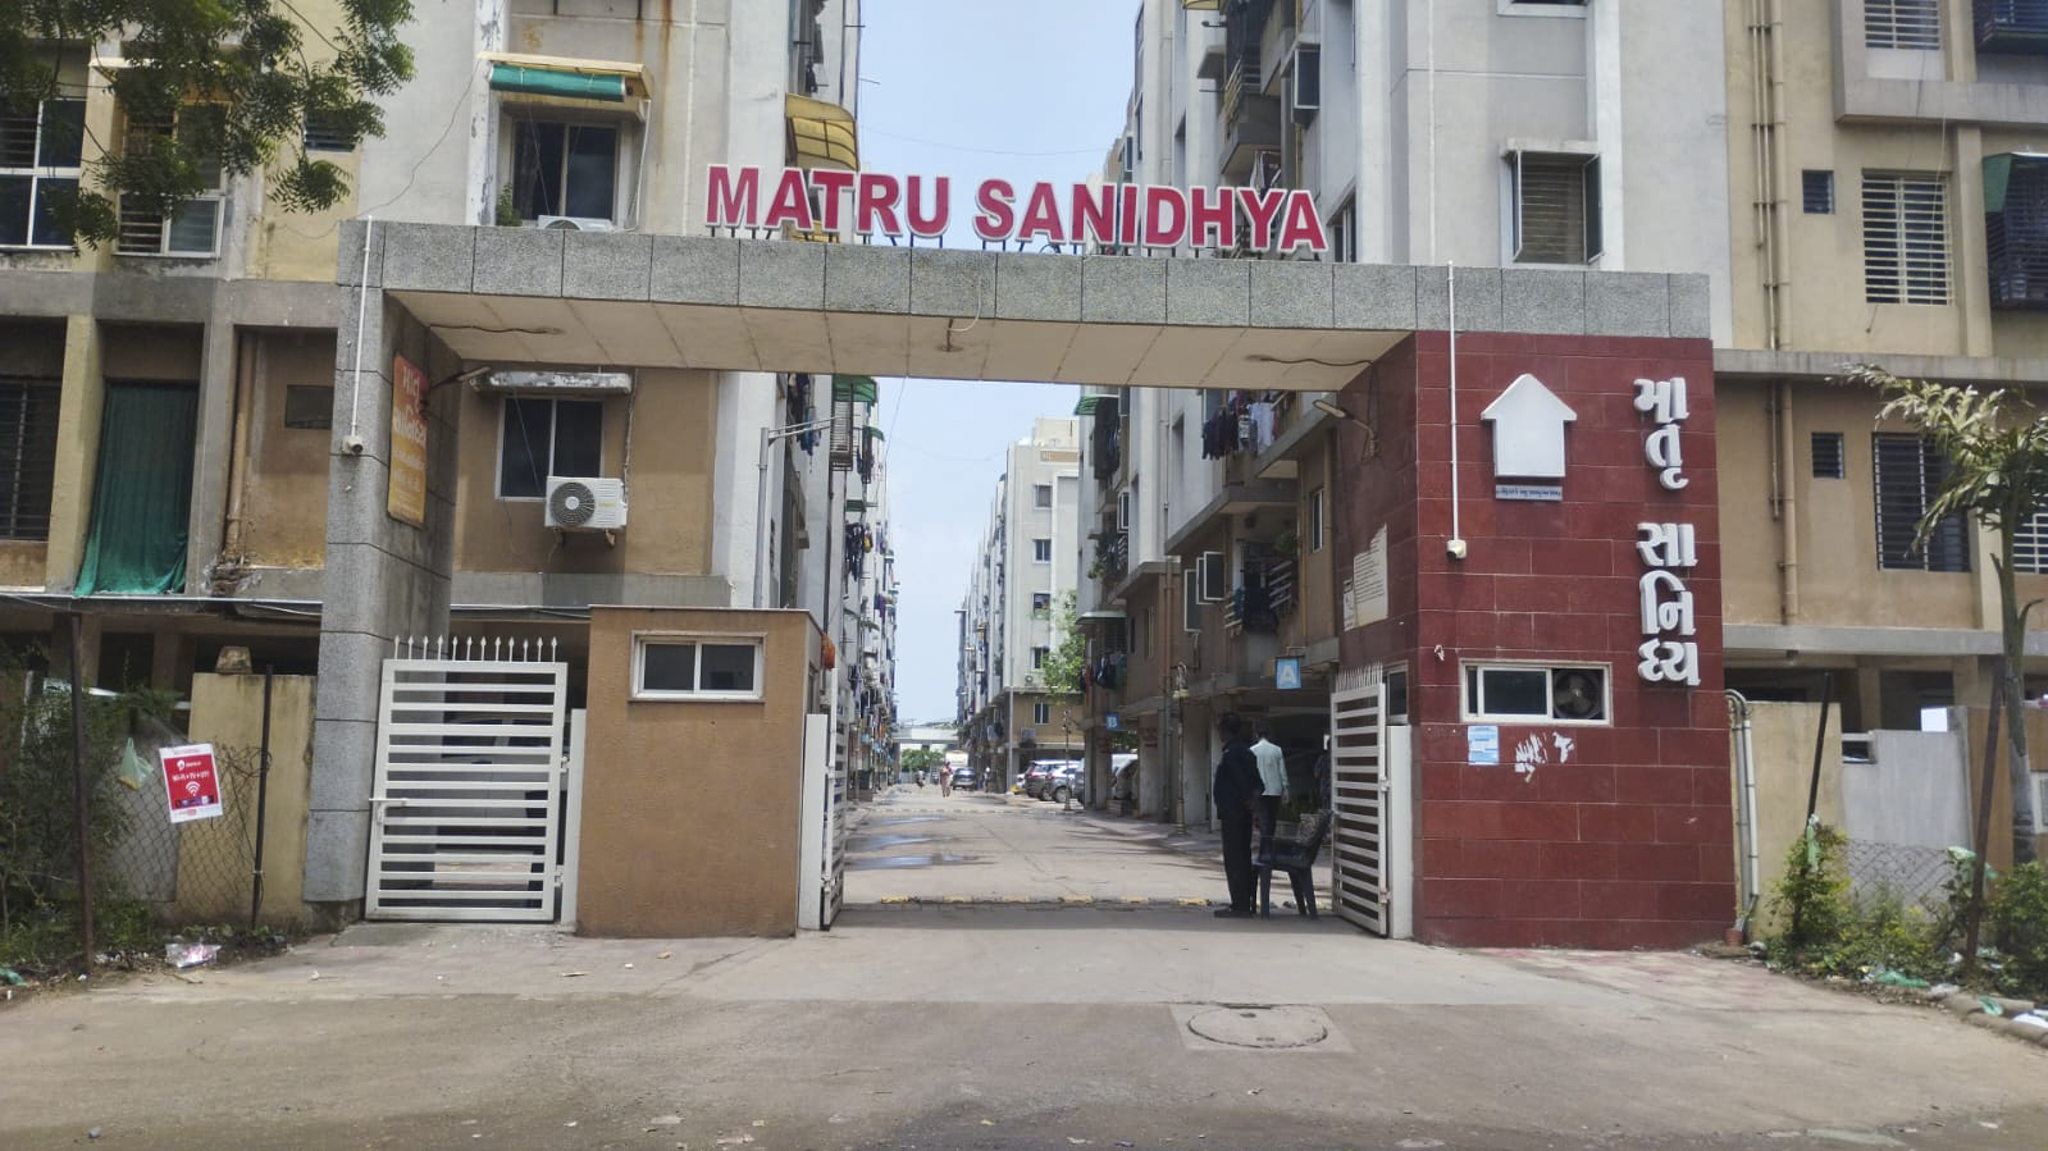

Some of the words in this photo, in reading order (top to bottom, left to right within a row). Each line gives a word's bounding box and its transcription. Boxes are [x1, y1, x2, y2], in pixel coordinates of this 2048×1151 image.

[706, 164, 950, 239] MATRU
[974, 178, 1329, 253] SANIDHYA
[1633, 376, 1691, 491] માતૃ
[1280, 665, 1297, 685] A
[1107, 716, 1118, 728] B
